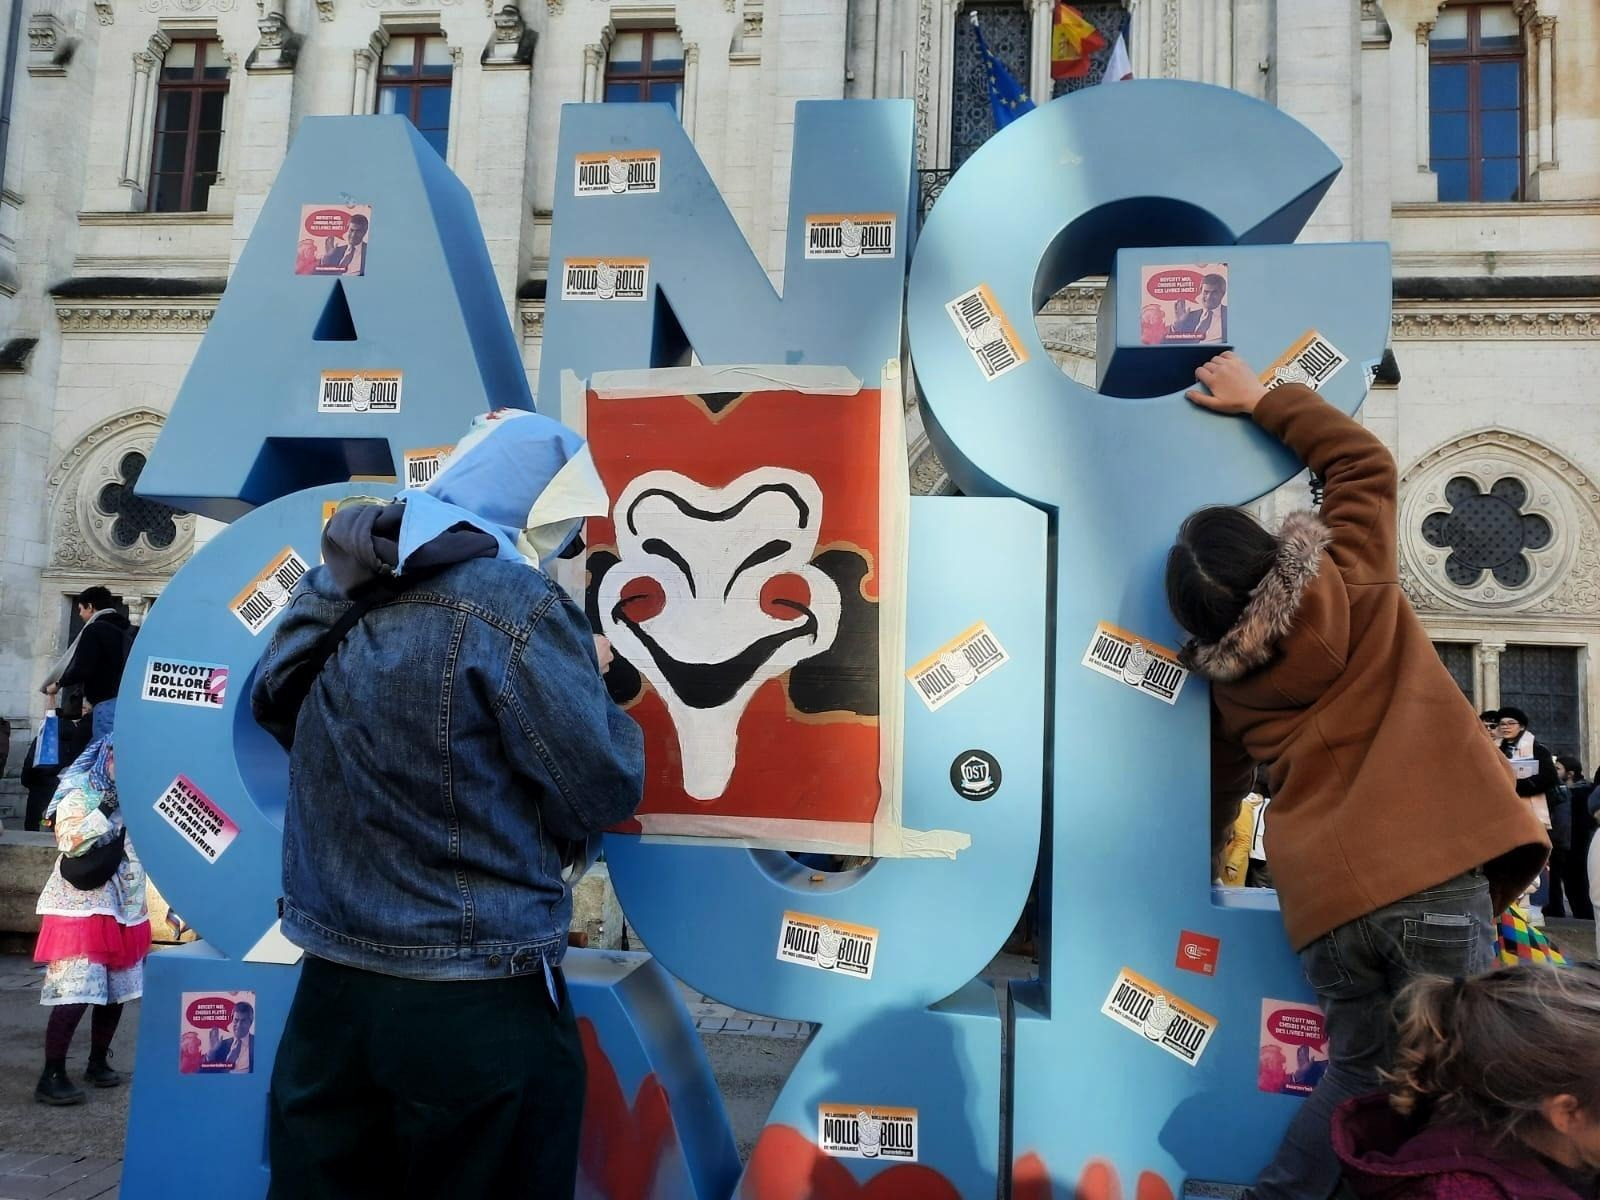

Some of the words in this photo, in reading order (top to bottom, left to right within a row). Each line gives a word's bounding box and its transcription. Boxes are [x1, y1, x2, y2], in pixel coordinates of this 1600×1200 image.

[580, 164, 609, 186] MOLLO
[628, 162, 655, 184] BOLLO
[810, 227, 842, 248] MOLLO
[862, 226, 891, 248] BOLLO
[567, 269, 598, 290] MOLLO
[616, 270, 644, 290] BOLLO
[957, 294, 990, 329] MOLLO
[983, 339, 1015, 371] BOLLO
[1298, 341, 1335, 377] BOLLO
[324, 382, 354, 402] MOLLO
[370, 382, 397, 402] BOLLO
[240, 592, 272, 625] MOLLO
[275, 558, 305, 589] BOLLO
[153, 662, 215, 677] BOYCOTT
[918, 664, 955, 699] MOLLO
[963, 634, 997, 668] BOLLO
[1092, 636, 1131, 668] MOLLO
[1145, 659, 1182, 691] BOLLO
[149, 687, 218, 703] HACHETTE
[151, 675, 211, 689] BOLLORÉ
[171, 788, 187, 804] PAS
[177, 781, 187, 792] NE
[187, 790, 224, 827] LAISSONS
[159, 802, 175, 818] DES
[174, 816, 216, 857] LIBRAIRIES
[165, 795, 207, 836] S'EMPARER
[784, 926, 819, 954] MOLLO
[838, 938, 871, 965] BOLLO
[1112, 983, 1154, 1021] MOLLO
[1166, 1015, 1205, 1051] BOLLO
[824, 1119, 859, 1144] MOLLO
[881, 1122, 912, 1148] BOLLO
